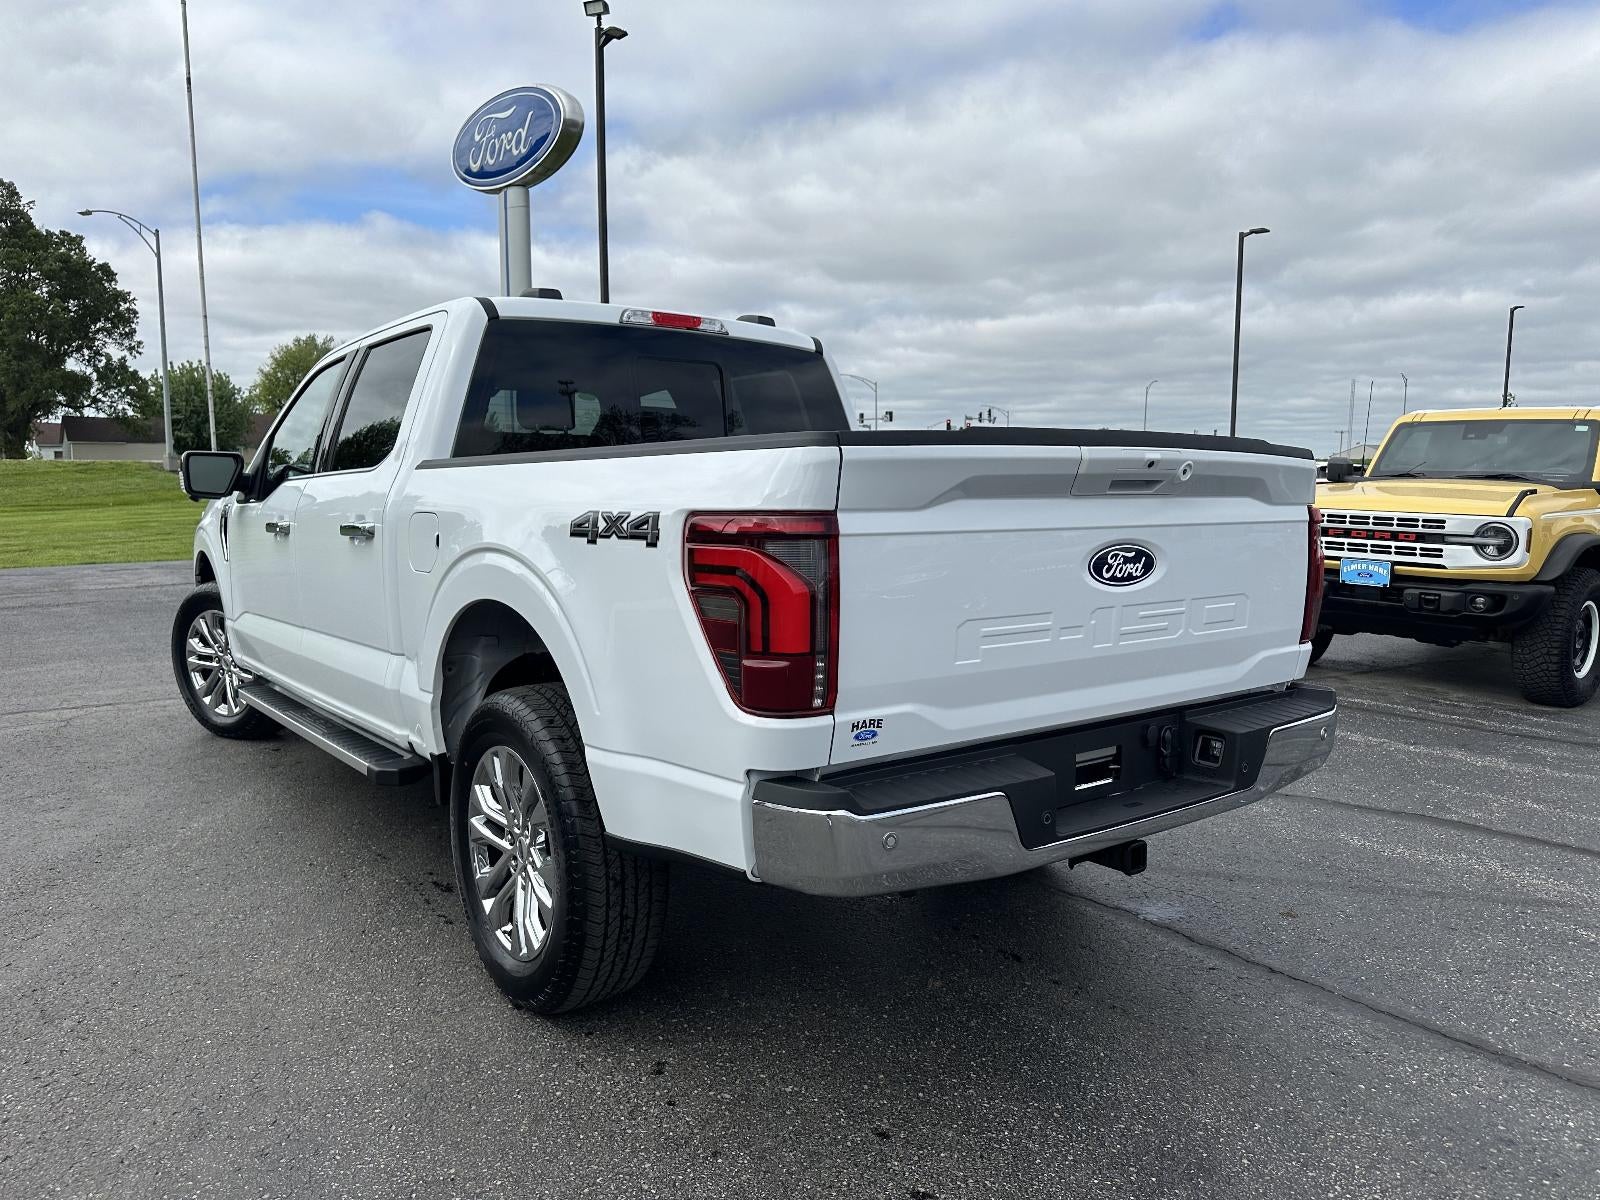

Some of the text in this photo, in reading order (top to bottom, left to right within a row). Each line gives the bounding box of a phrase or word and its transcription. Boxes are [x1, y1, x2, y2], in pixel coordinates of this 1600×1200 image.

[470, 106, 534, 172] Ford
[1328, 529, 1417, 541] FORD
[1102, 549, 1145, 579] Ford
[1343, 563, 1388, 577] ELMER HARE
[954, 593, 1249, 664] F-150
[851, 718, 883, 733] HARE
